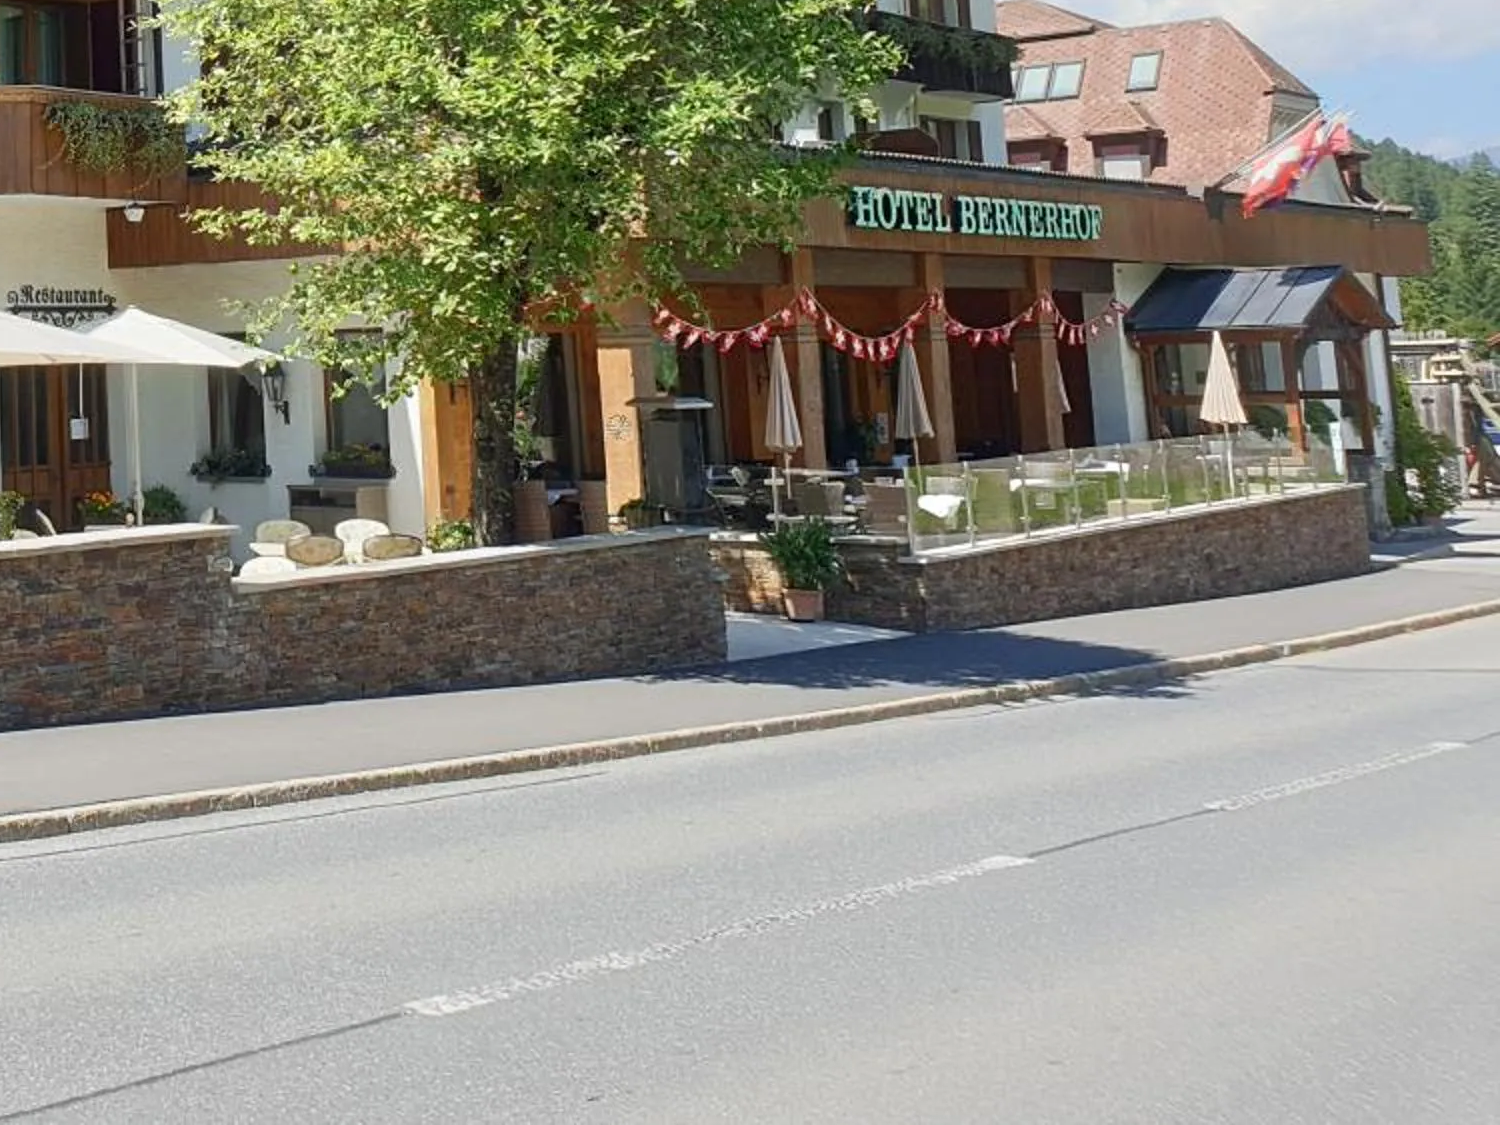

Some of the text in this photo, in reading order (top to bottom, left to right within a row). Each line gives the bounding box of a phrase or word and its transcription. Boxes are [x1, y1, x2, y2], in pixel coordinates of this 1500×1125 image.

[851, 186, 1102, 240] HOTEL BERNERHOF
[20, 284, 104, 303] Restaurant
